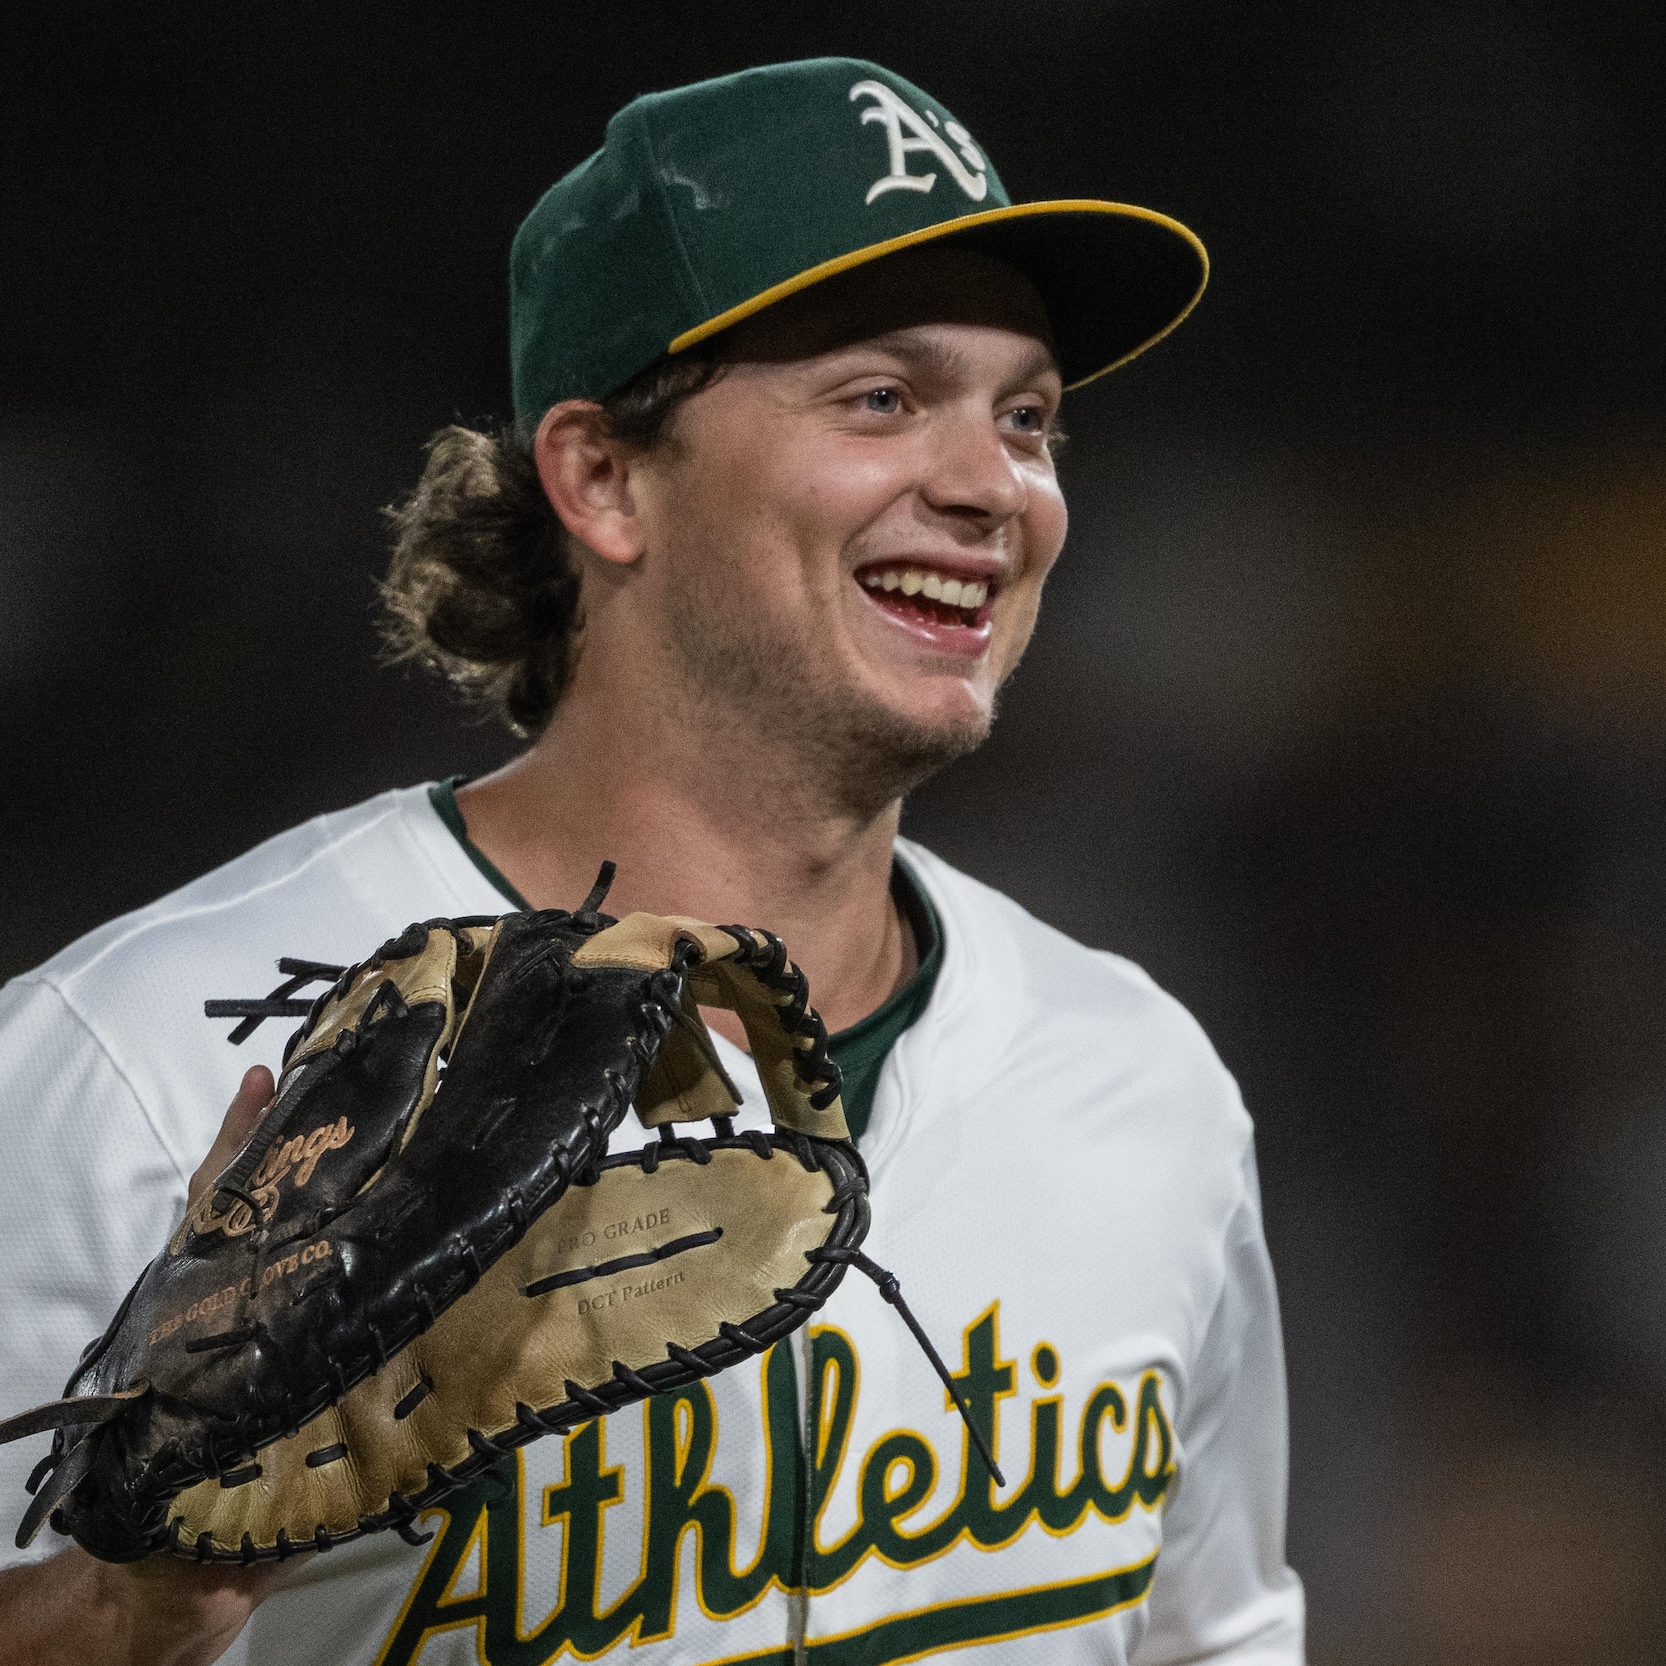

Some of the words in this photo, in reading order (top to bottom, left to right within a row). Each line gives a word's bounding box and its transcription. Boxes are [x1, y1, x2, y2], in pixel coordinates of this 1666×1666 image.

[556, 1231, 597, 1255] PRO
[602, 1207, 671, 1240] GRADE
[185, 1285, 237, 1323] GOLD
[239, 1252, 300, 1297] GOVE
[577, 1289, 618, 1316] DCT
[621, 1271, 686, 1303] Pattern
